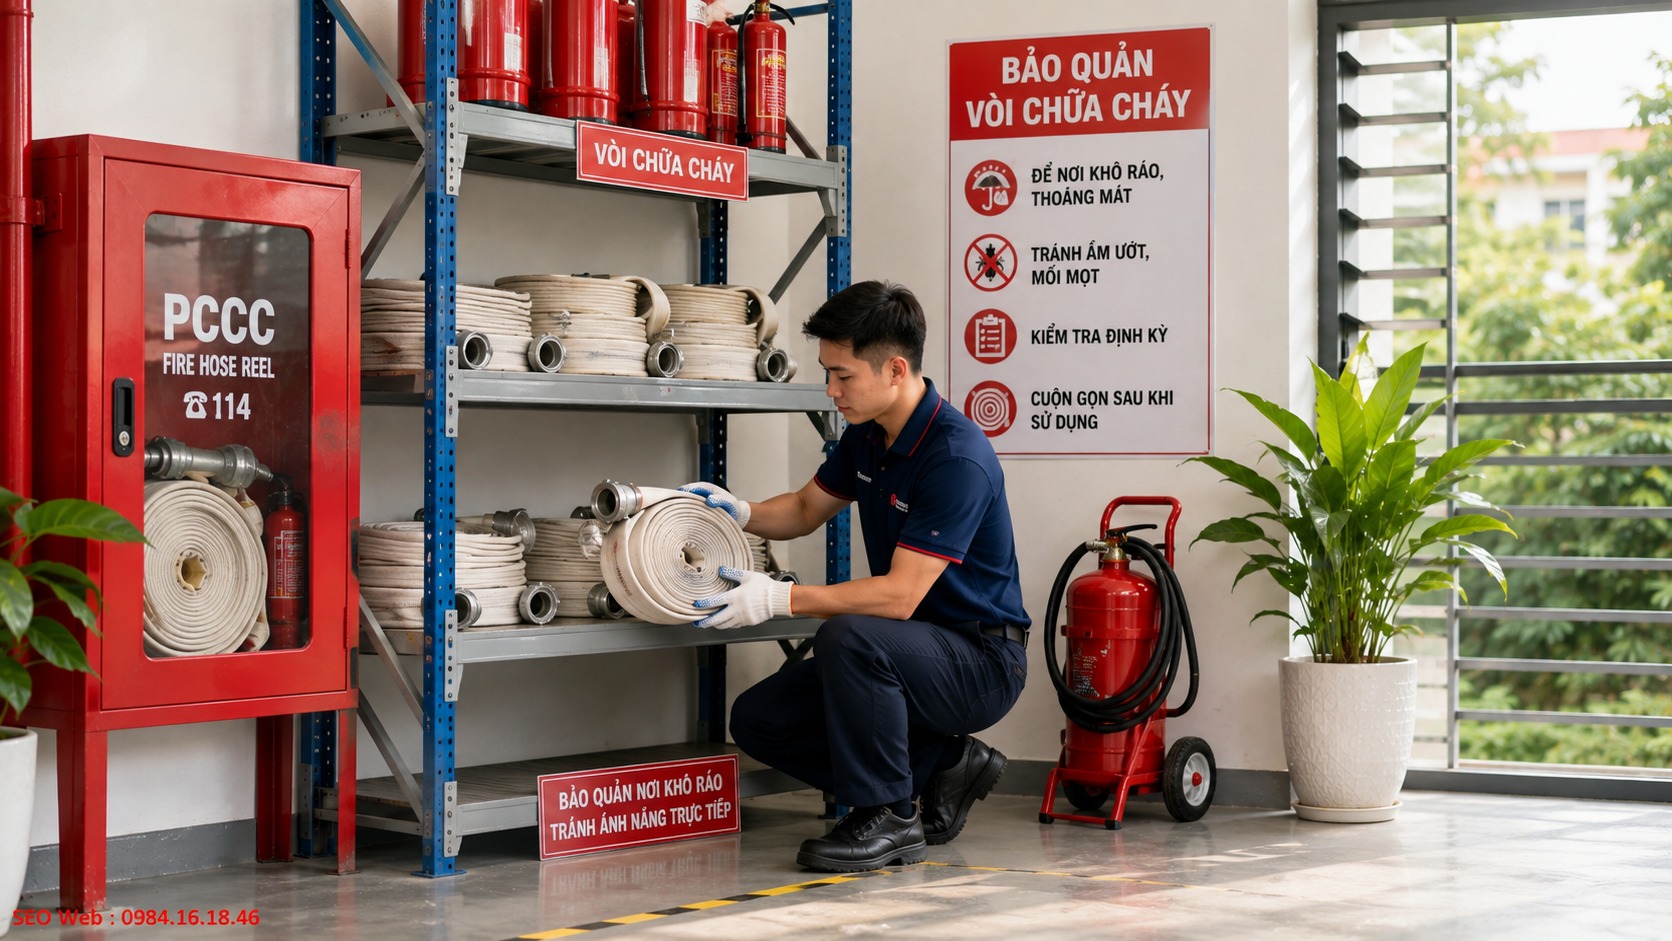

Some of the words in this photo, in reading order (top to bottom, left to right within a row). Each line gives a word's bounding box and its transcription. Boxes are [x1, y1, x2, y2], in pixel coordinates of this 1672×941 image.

[1001, 45, 1062, 84] BẢO
[1071, 41, 1153, 83] QUẢN
[965, 92, 1013, 128] VÒI
[1022, 88, 1104, 126] CHỮA
[1111, 83, 1192, 121] CHÁY
[594, 138, 627, 168] VÒI
[632, 147, 684, 177] CHỮA
[687, 156, 734, 184] CHÁY
[1031, 161, 1053, 183] ĐỂ
[1057, 165, 1084, 182] NƠI
[1089, 161, 1122, 181] KHÔ
[1127, 160, 1164, 181] RÁO,
[1031, 187, 1094, 206] THOÁNG
[1099, 185, 1132, 204] MÁT
[1031, 243, 1082, 262] TRÁNH
[1066, 268, 1100, 287] MỌT
[164, 292, 275, 346] PCCC
[1031, 322, 1068, 345] KIỂM
[1072, 329, 1101, 344] TRA
[1105, 328, 1143, 347] ĐỊNH
[1148, 324, 1168, 343] KỲ
[163, 352, 195, 375] FIRE
[200, 354, 237, 377] HOSE
[241, 356, 275, 379] REEL
[212, 391, 251, 420] 114
[1031, 387, 1072, 409] CUỘN
[1077, 390, 1108, 409] GỌN
[1113, 390, 1143, 406] SAU
[1148, 390, 1174, 405] KHI
[1031, 410, 1052, 429] SỬ
[1055, 414, 1098, 433] DỤNG
[559, 784, 589, 810] BẢO
[593, 778, 632, 807] QUẢN
[637, 779, 660, 800] NƠI
[696, 769, 723, 793] RÁO
[550, 816, 596, 841] TRÁNH
[670, 803, 703, 827] TRỰC
